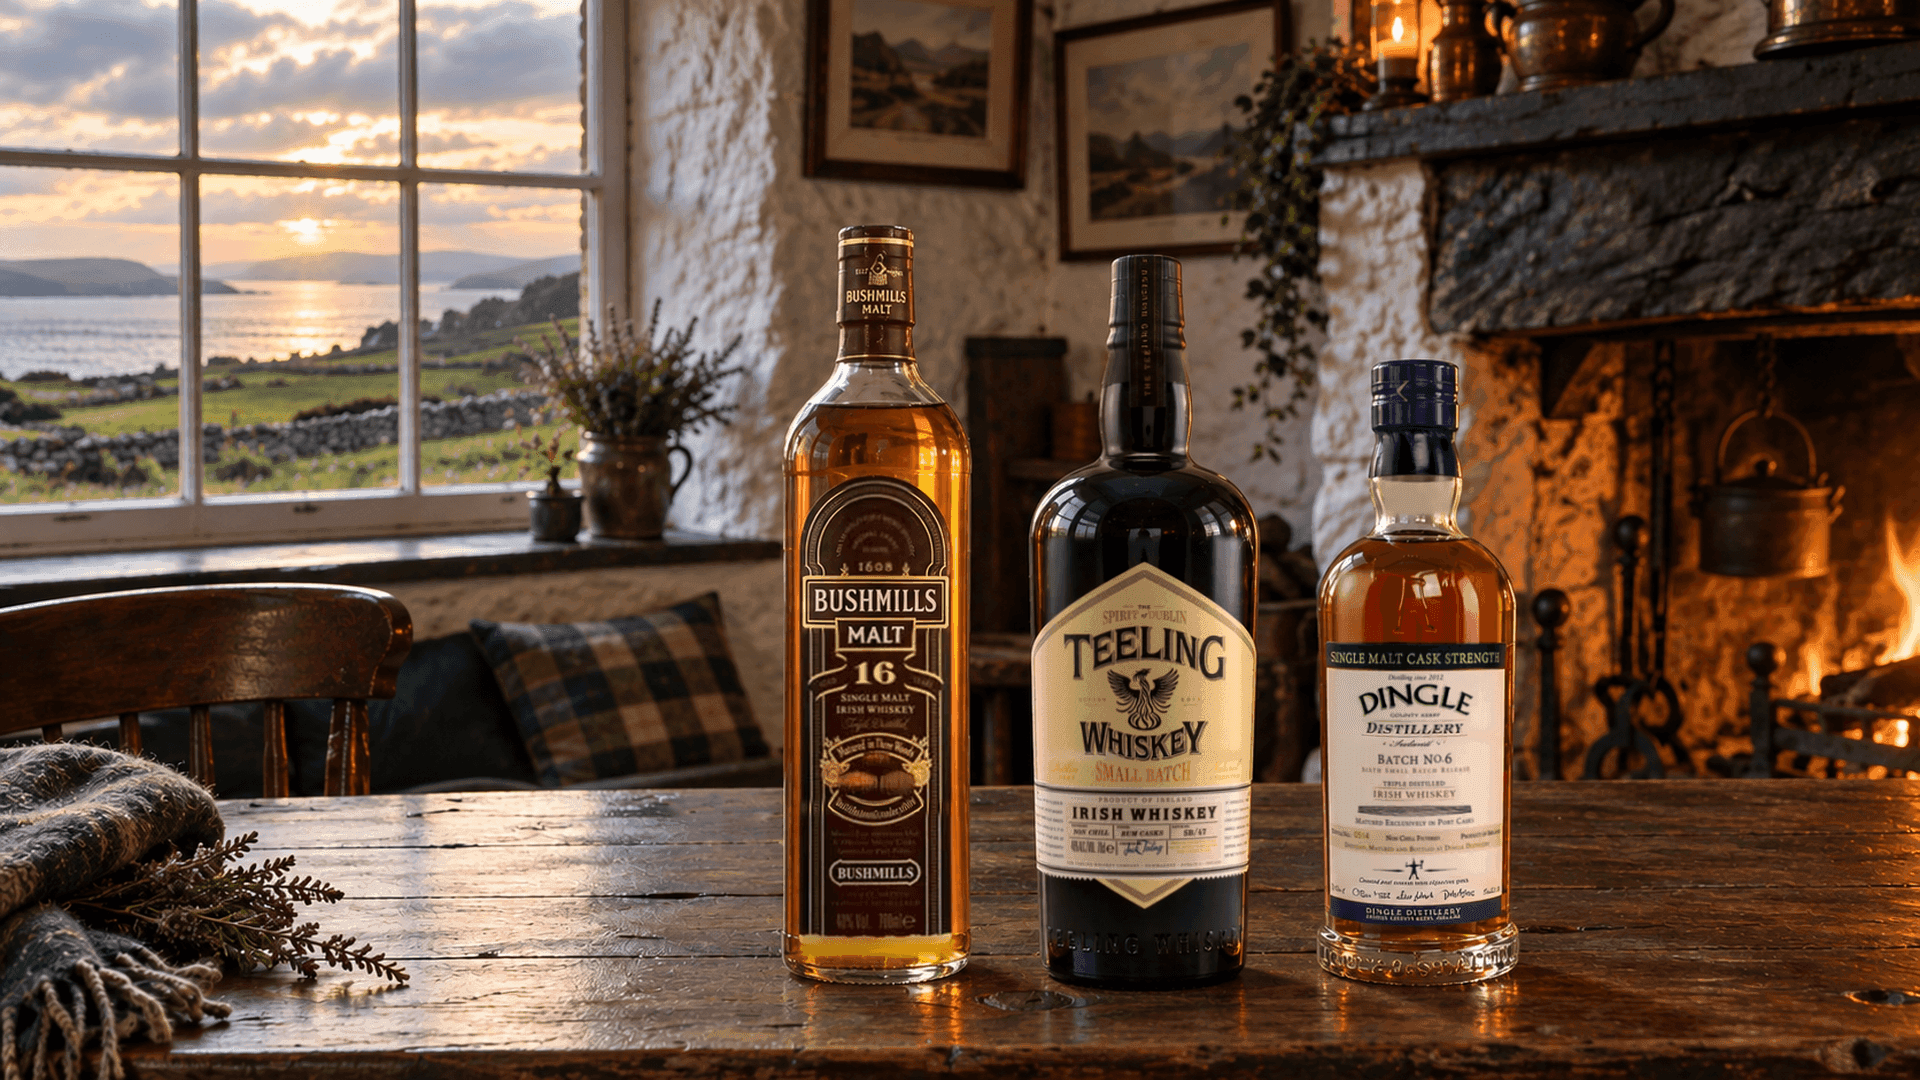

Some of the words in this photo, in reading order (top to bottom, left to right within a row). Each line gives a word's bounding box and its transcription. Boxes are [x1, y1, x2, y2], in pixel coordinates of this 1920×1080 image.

[846, 289, 907, 304] BUSHMILLS
[862, 304, 892, 314] MALT
[858, 561, 893, 572] 1608
[814, 588, 937, 612] BUSHMILLS
[1102, 610, 1139, 625] SPIRIT
[1149, 610, 1187, 625] DUBLIN
[847, 626, 905, 644] MALT
[1063, 625, 1227, 681] TEELING
[1329, 651, 1365, 665] SINGLE
[1368, 652, 1403, 665] MALT
[1406, 652, 1442, 665] CASK
[1444, 651, 1500, 665] STRENGTH
[855, 661, 897, 685] 16
[840, 693, 879, 702] SINGLE
[881, 693, 911, 702] MALT
[1358, 683, 1474, 716] DINGLE
[836, 705, 865, 714] IRISH
[867, 705, 915, 714] WHISKEY
[1366, 722, 1464, 735] DISTILLERY
[1080, 720, 1208, 762] WHISKEY
[1377, 754, 1419, 765] BATCH
[1095, 760, 1143, 783] SMALL
[1145, 760, 1192, 783] BATCH
[1373, 790, 1401, 799] IRISH
[1405, 790, 1456, 799] WHISKEY
[1072, 806, 1123, 821] IRISH
[1130, 805, 1218, 821] WHISKEY
[1139, 829, 1164, 837] CASKS
[837, 866, 915, 880] BUSHMILLS
[1365, 907, 1402, 916] DINGLE
